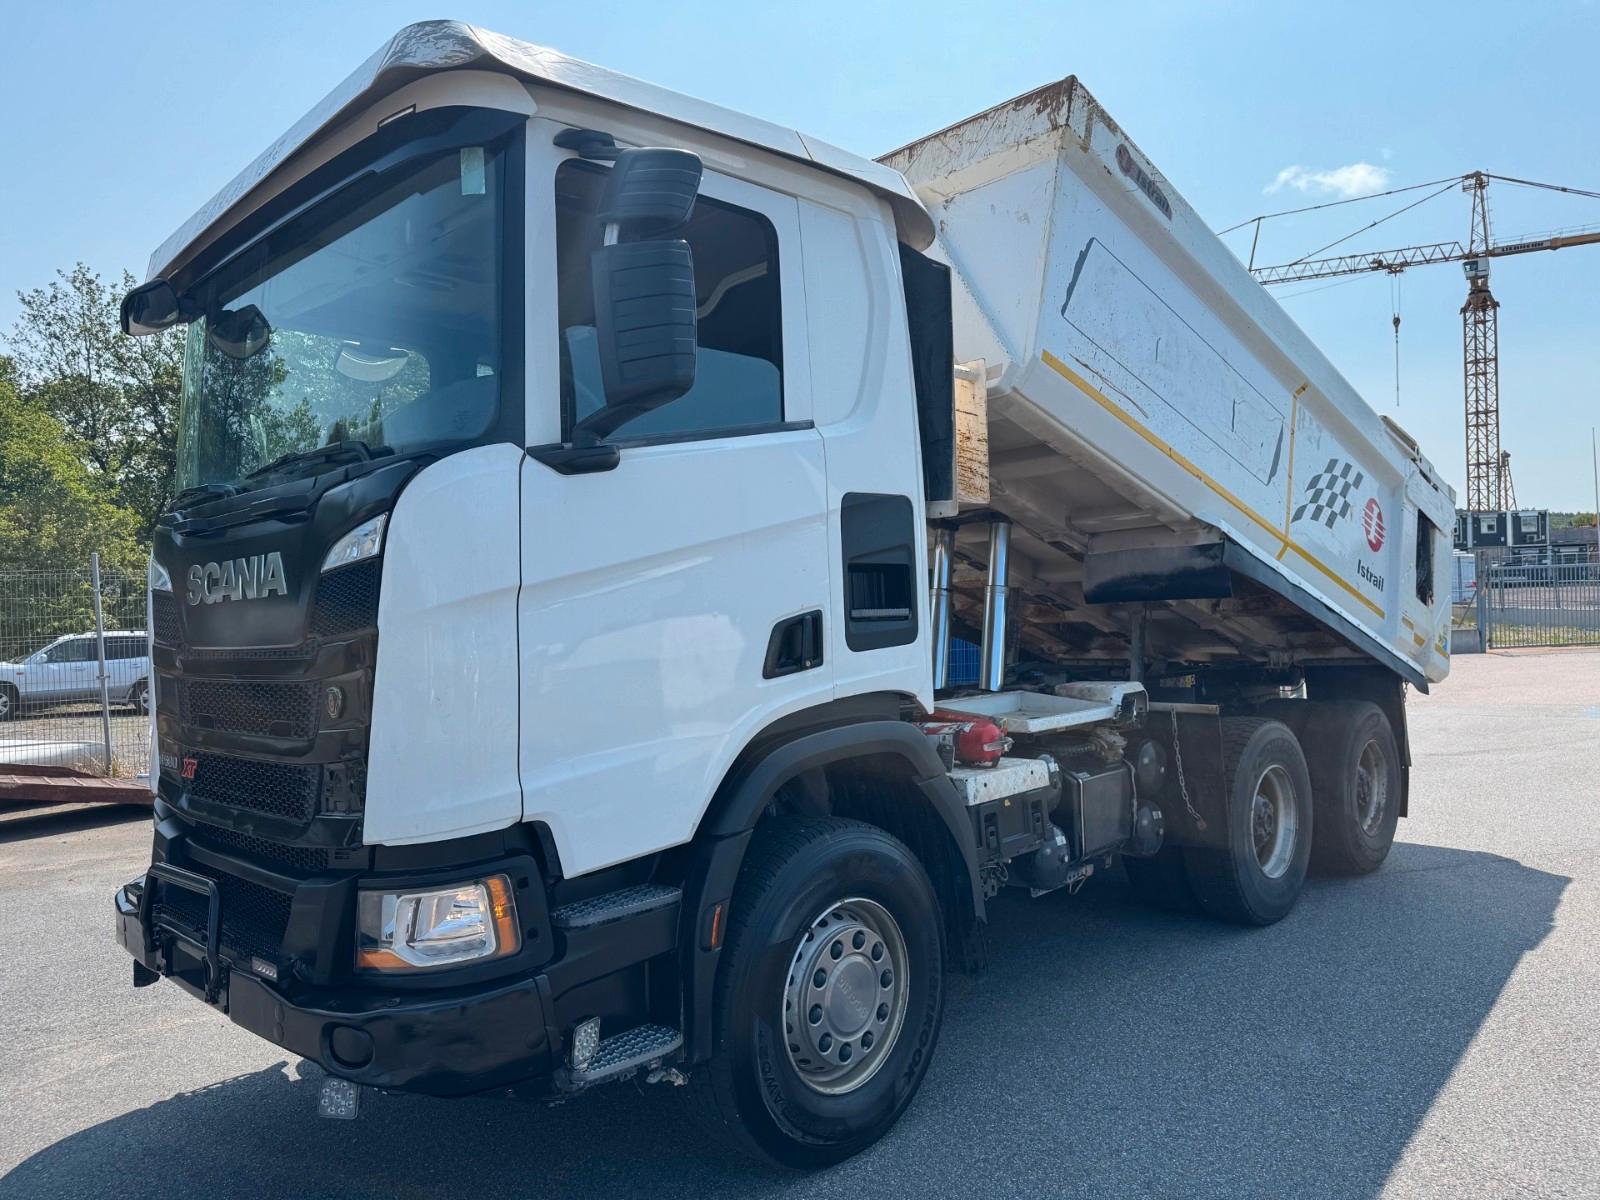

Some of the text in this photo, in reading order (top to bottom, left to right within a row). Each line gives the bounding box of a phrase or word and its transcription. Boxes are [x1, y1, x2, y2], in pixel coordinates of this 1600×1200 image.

[186, 551, 288, 606] SCANIA
[1357, 559, 1384, 592] Istrail
[181, 758, 198, 779] XT
